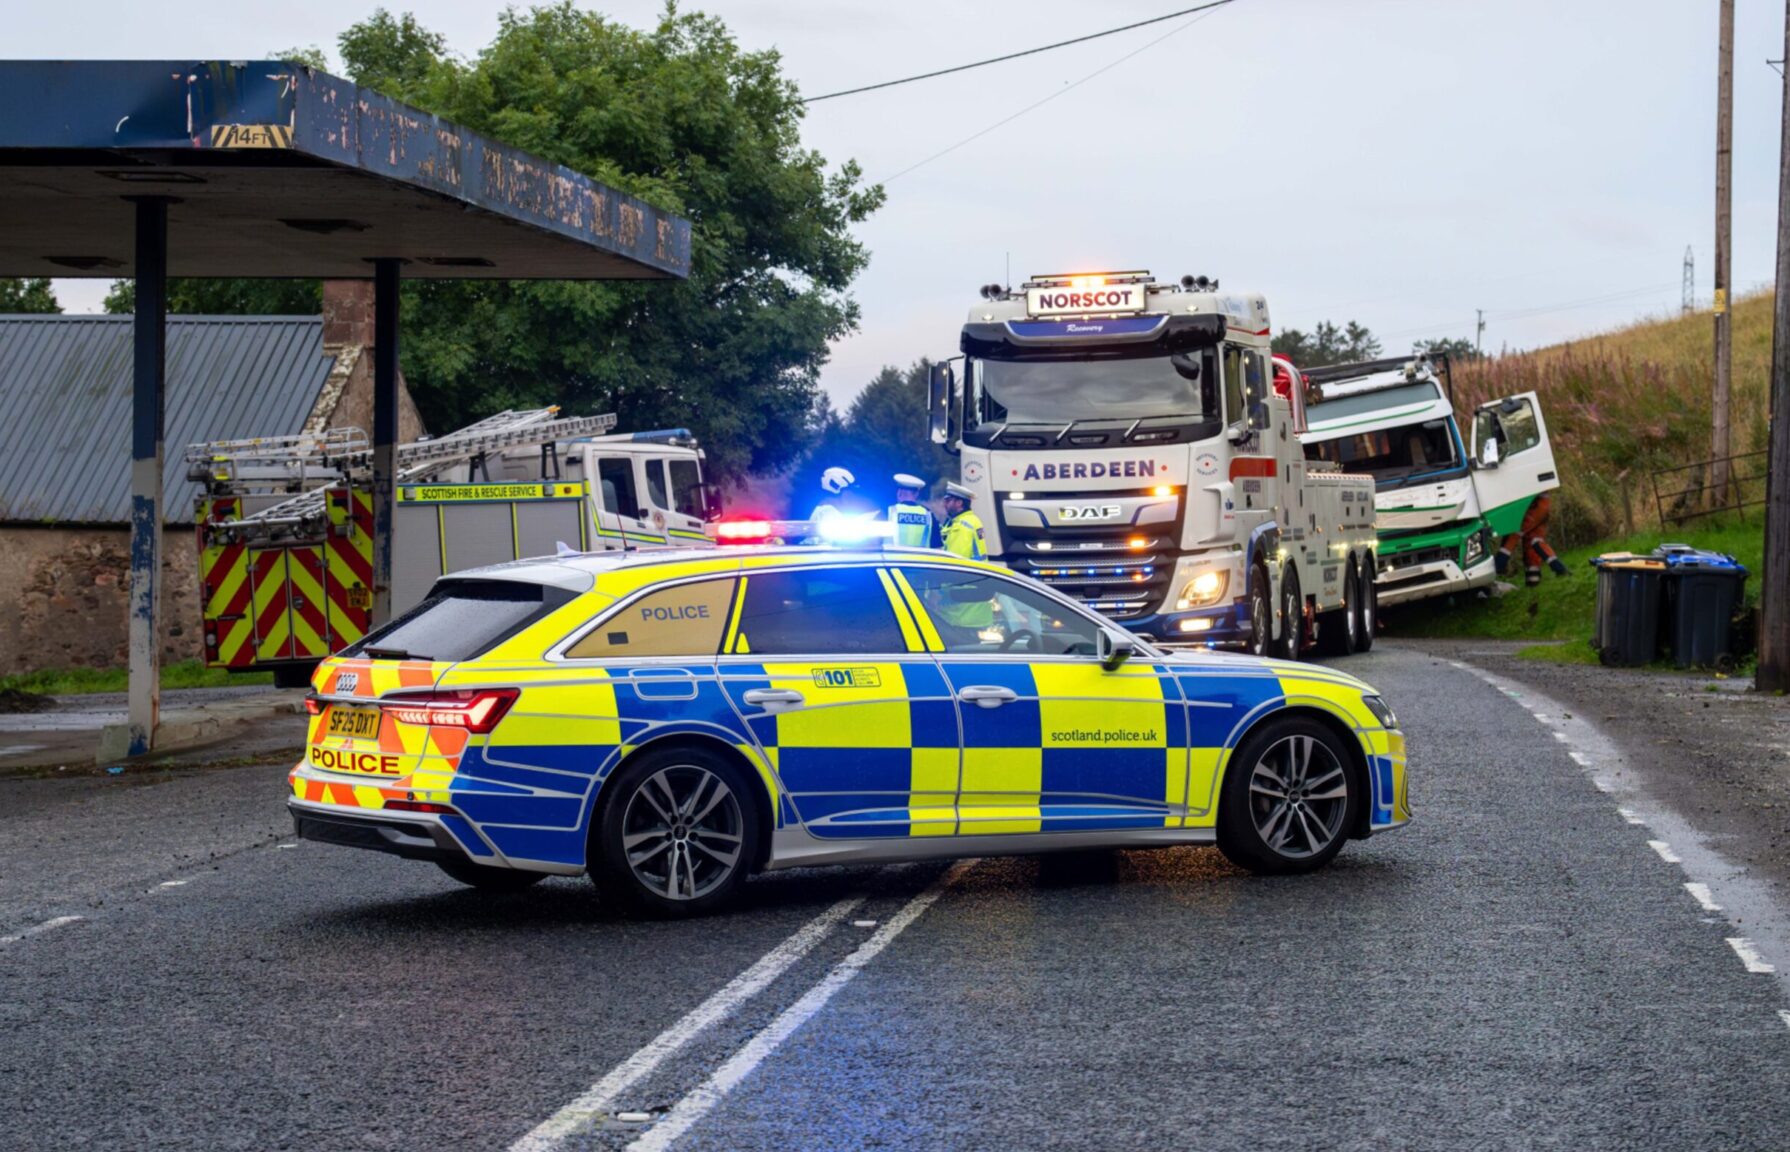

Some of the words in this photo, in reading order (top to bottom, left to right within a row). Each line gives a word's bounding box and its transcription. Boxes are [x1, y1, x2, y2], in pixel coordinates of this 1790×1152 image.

[1040, 291, 1132, 309] NORSCOT
[1066, 324, 1104, 333] Recovery
[1023, 460, 1155, 481] ABERDEEN
[422, 487, 456, 499] SCOTTISH
[458, 486, 473, 499] FIRE
[474, 486, 480, 498] &
[481, 486, 508, 498] RESCUE
[509, 485, 537, 497] SERVICE
[899, 514, 927, 525] POLICE
[1059, 505, 1122, 520] DAF
[641, 604, 710, 621] POLICE
[825, 670, 853, 685] 101
[330, 710, 355, 733] SF25
[355, 712, 377, 735] DXT
[1051, 729, 1157, 744] scotland.police.uk
[312, 747, 400, 775] POLICE
